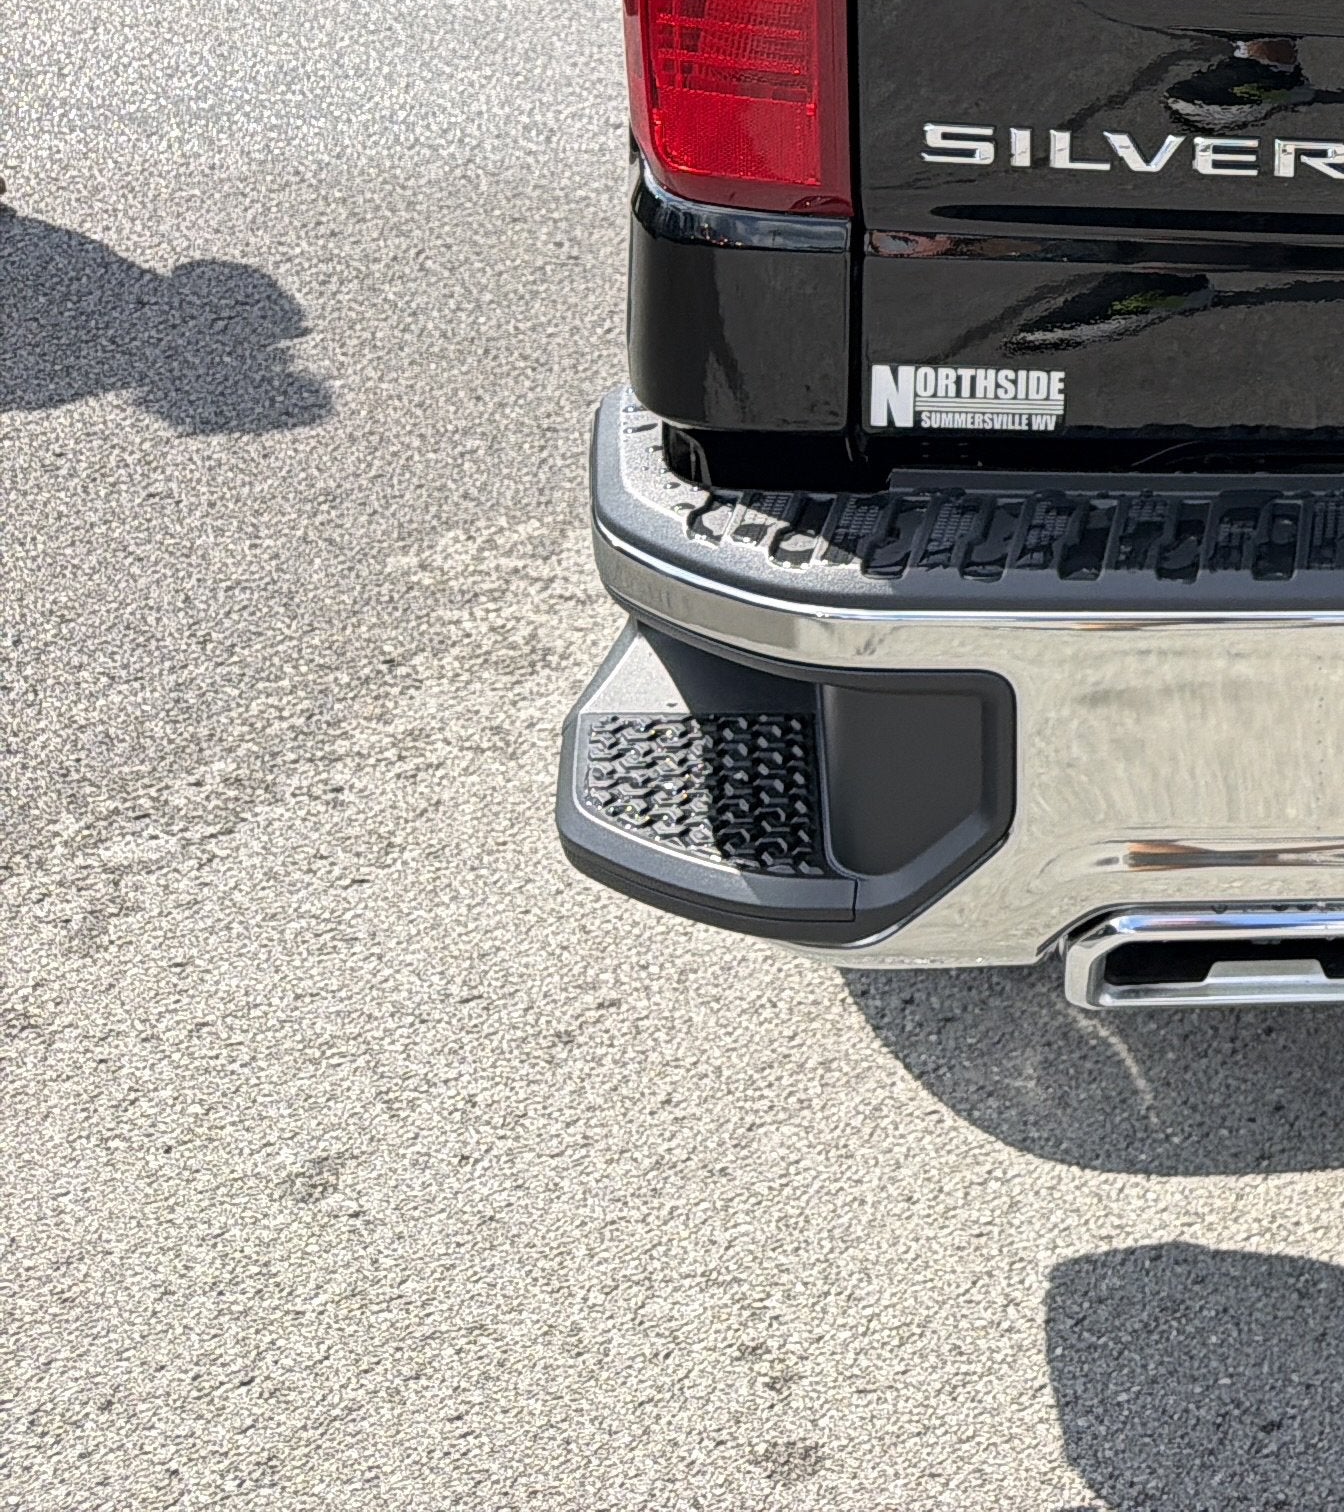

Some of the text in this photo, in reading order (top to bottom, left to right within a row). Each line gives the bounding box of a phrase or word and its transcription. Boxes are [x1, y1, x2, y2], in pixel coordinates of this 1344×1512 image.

[870, 364, 1066, 428] NORTHSIDE
[920, 411, 1057, 431] SUMMERSVILLE WV
